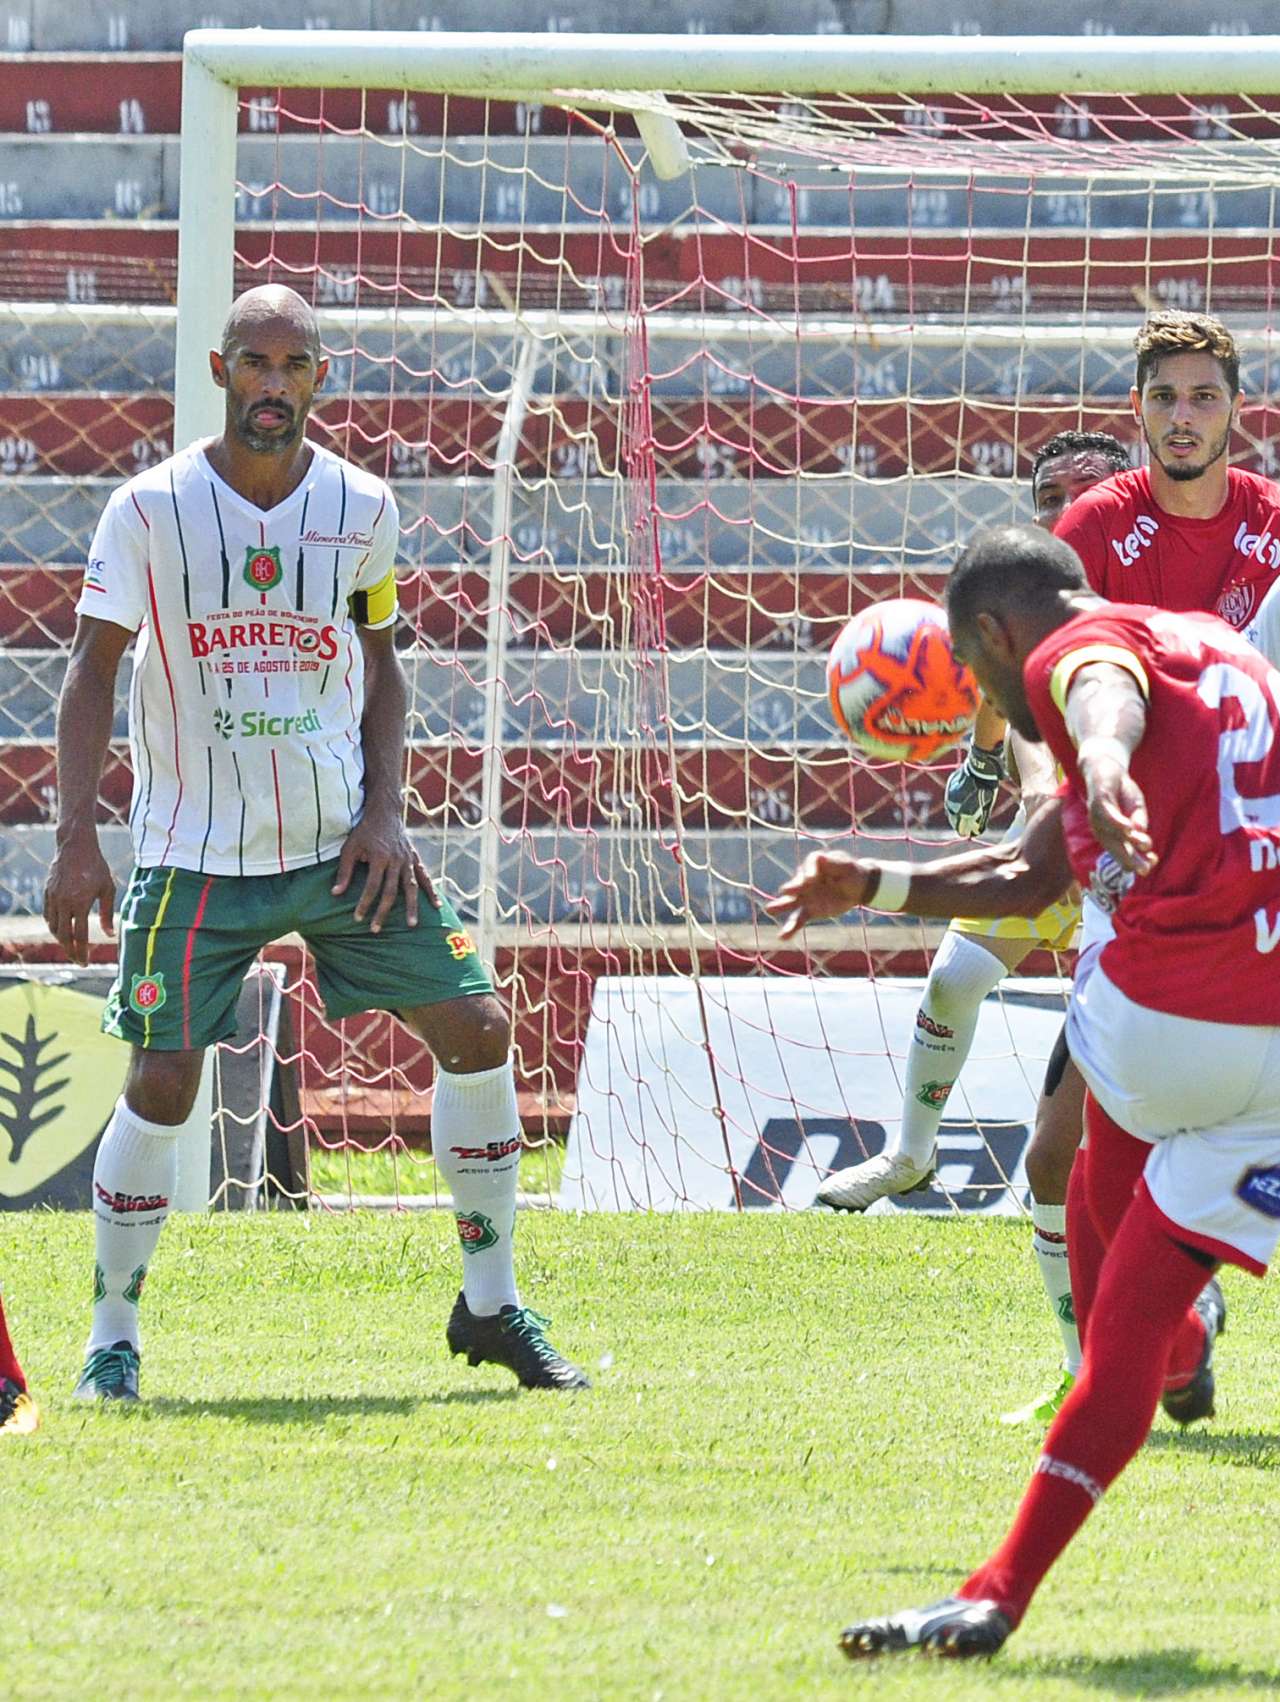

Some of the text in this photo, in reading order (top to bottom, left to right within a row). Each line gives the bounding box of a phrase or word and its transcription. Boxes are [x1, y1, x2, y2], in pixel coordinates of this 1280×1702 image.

[187, 622, 338, 661] BARRETOS
[237, 661, 251, 673] DE
[253, 660, 291, 673] AGOSTO
[240, 707, 323, 738] Sicredi
